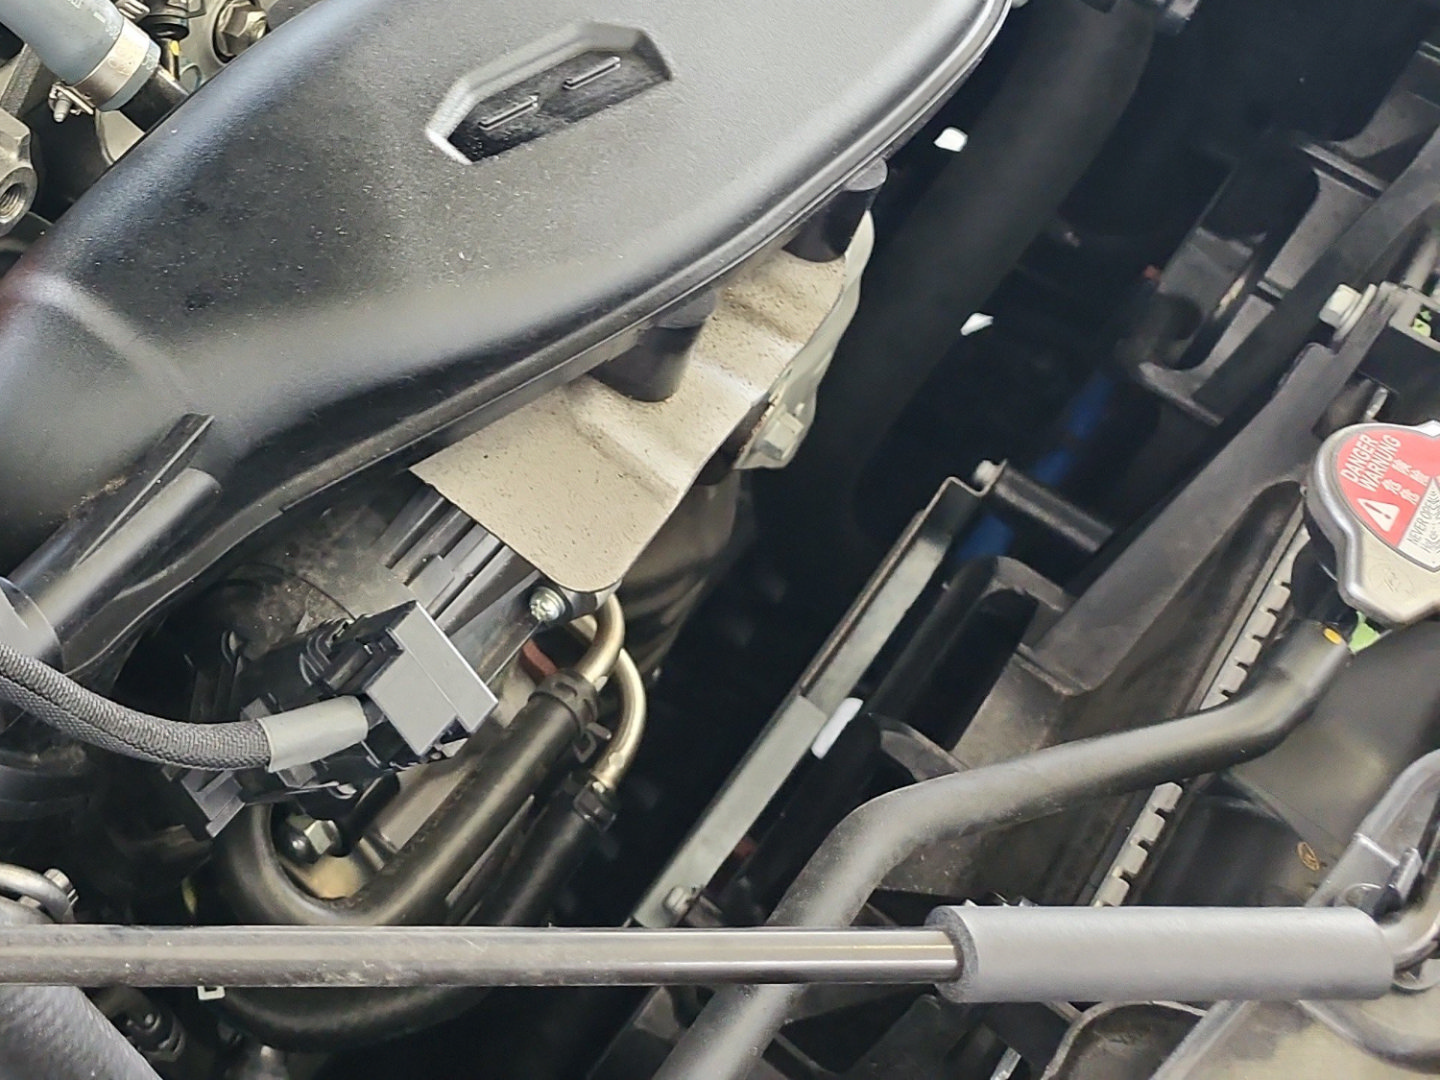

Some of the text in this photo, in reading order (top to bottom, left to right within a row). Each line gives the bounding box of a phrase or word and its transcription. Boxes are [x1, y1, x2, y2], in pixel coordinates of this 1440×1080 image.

[1340, 434, 1379, 482] DANGER
[1358, 434, 1402, 492] WARNUNG
[1406, 517, 1429, 545] NEVER
